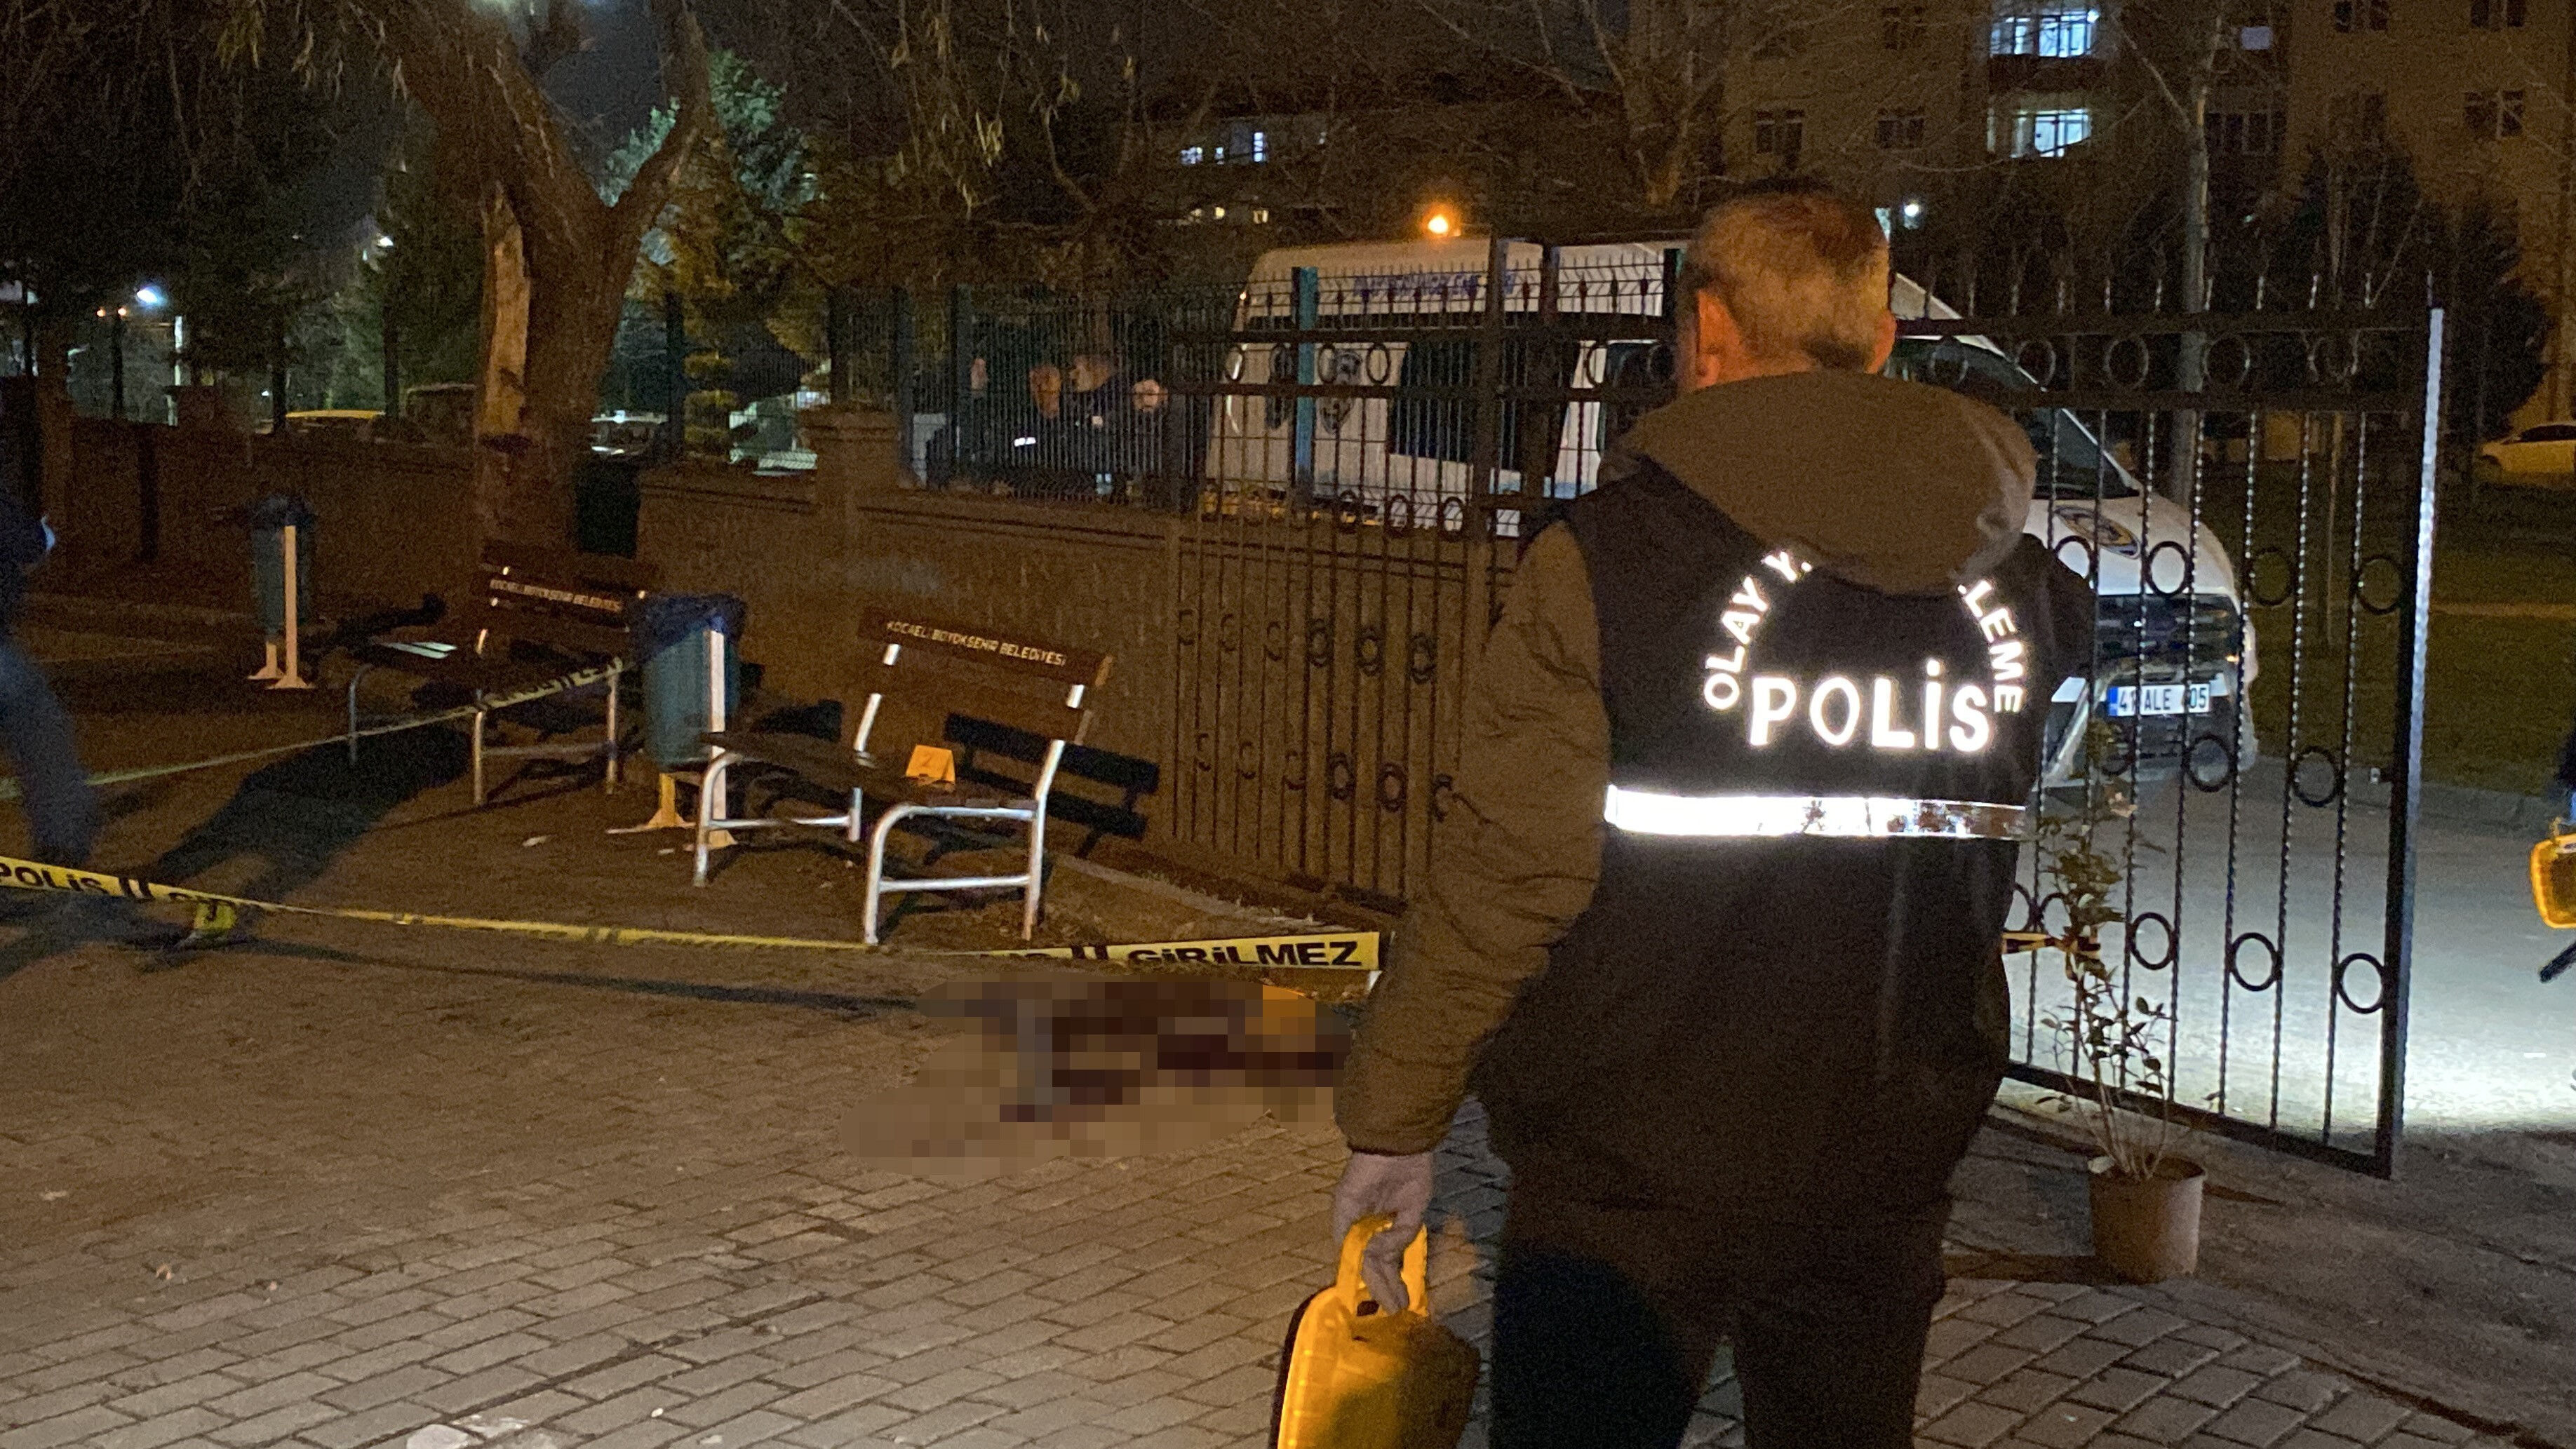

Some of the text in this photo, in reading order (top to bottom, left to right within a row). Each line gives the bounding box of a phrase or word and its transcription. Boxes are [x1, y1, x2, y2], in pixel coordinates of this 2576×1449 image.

[1704, 576, 1769, 709] OLAY
[1957, 580, 2024, 713] LEME
[2145, 688, 2172, 711] ALE
[2182, 687, 2207, 709] 05
